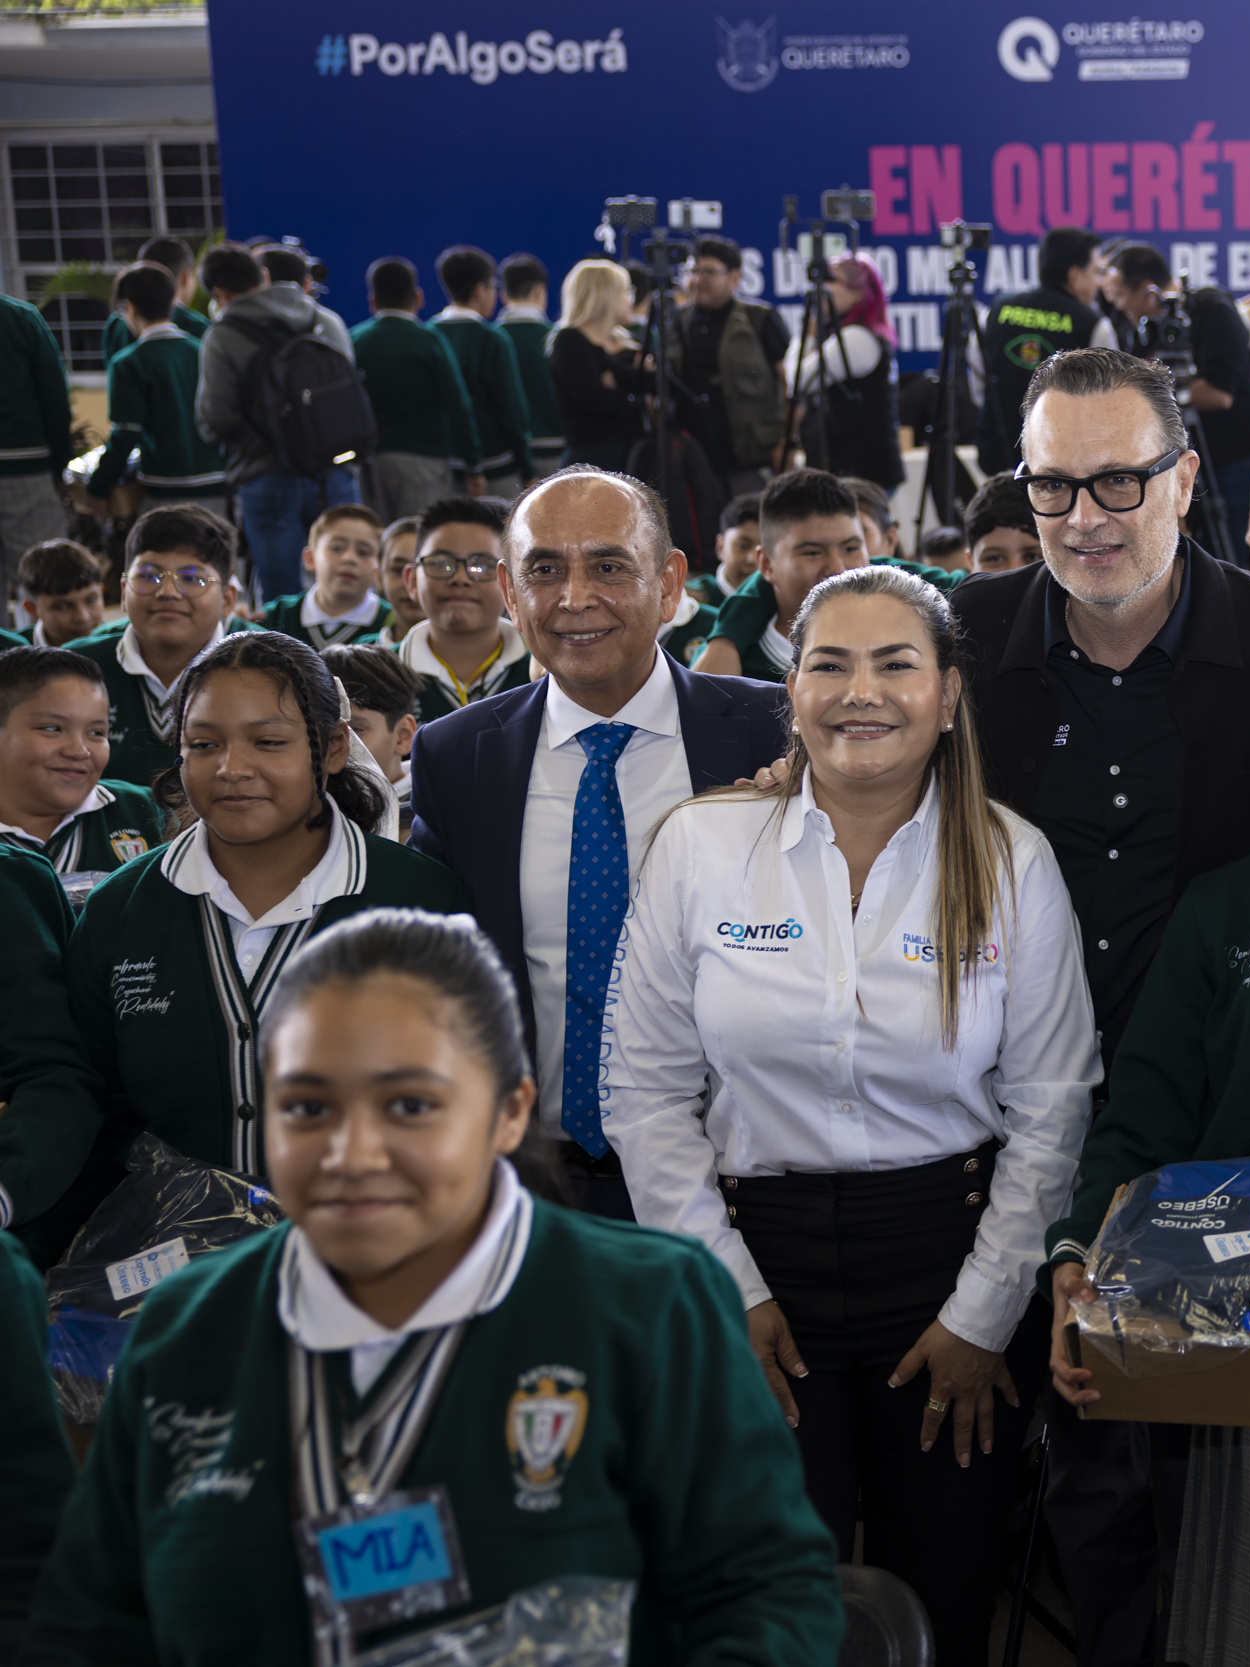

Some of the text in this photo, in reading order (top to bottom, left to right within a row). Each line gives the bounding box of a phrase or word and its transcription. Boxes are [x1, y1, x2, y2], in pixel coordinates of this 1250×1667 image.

[1062, 16, 1205, 45] QUERÉTARO
[316, 28, 628, 84] #PorAlgoSerá
[780, 43, 911, 70] QUERÉTARO
[869, 145, 962, 236] EN
[997, 304, 1074, 334] PRENSA
[717, 917, 803, 942] CONTIGO
[903, 933, 931, 946] FAMILIA
[746, 945, 789, 953] AVANZAMOS
[1157, 1195, 1231, 1212] USEBEQ
[1151, 1218, 1226, 1230] CONTIGO
[330, 1521, 437, 1591] MIA
